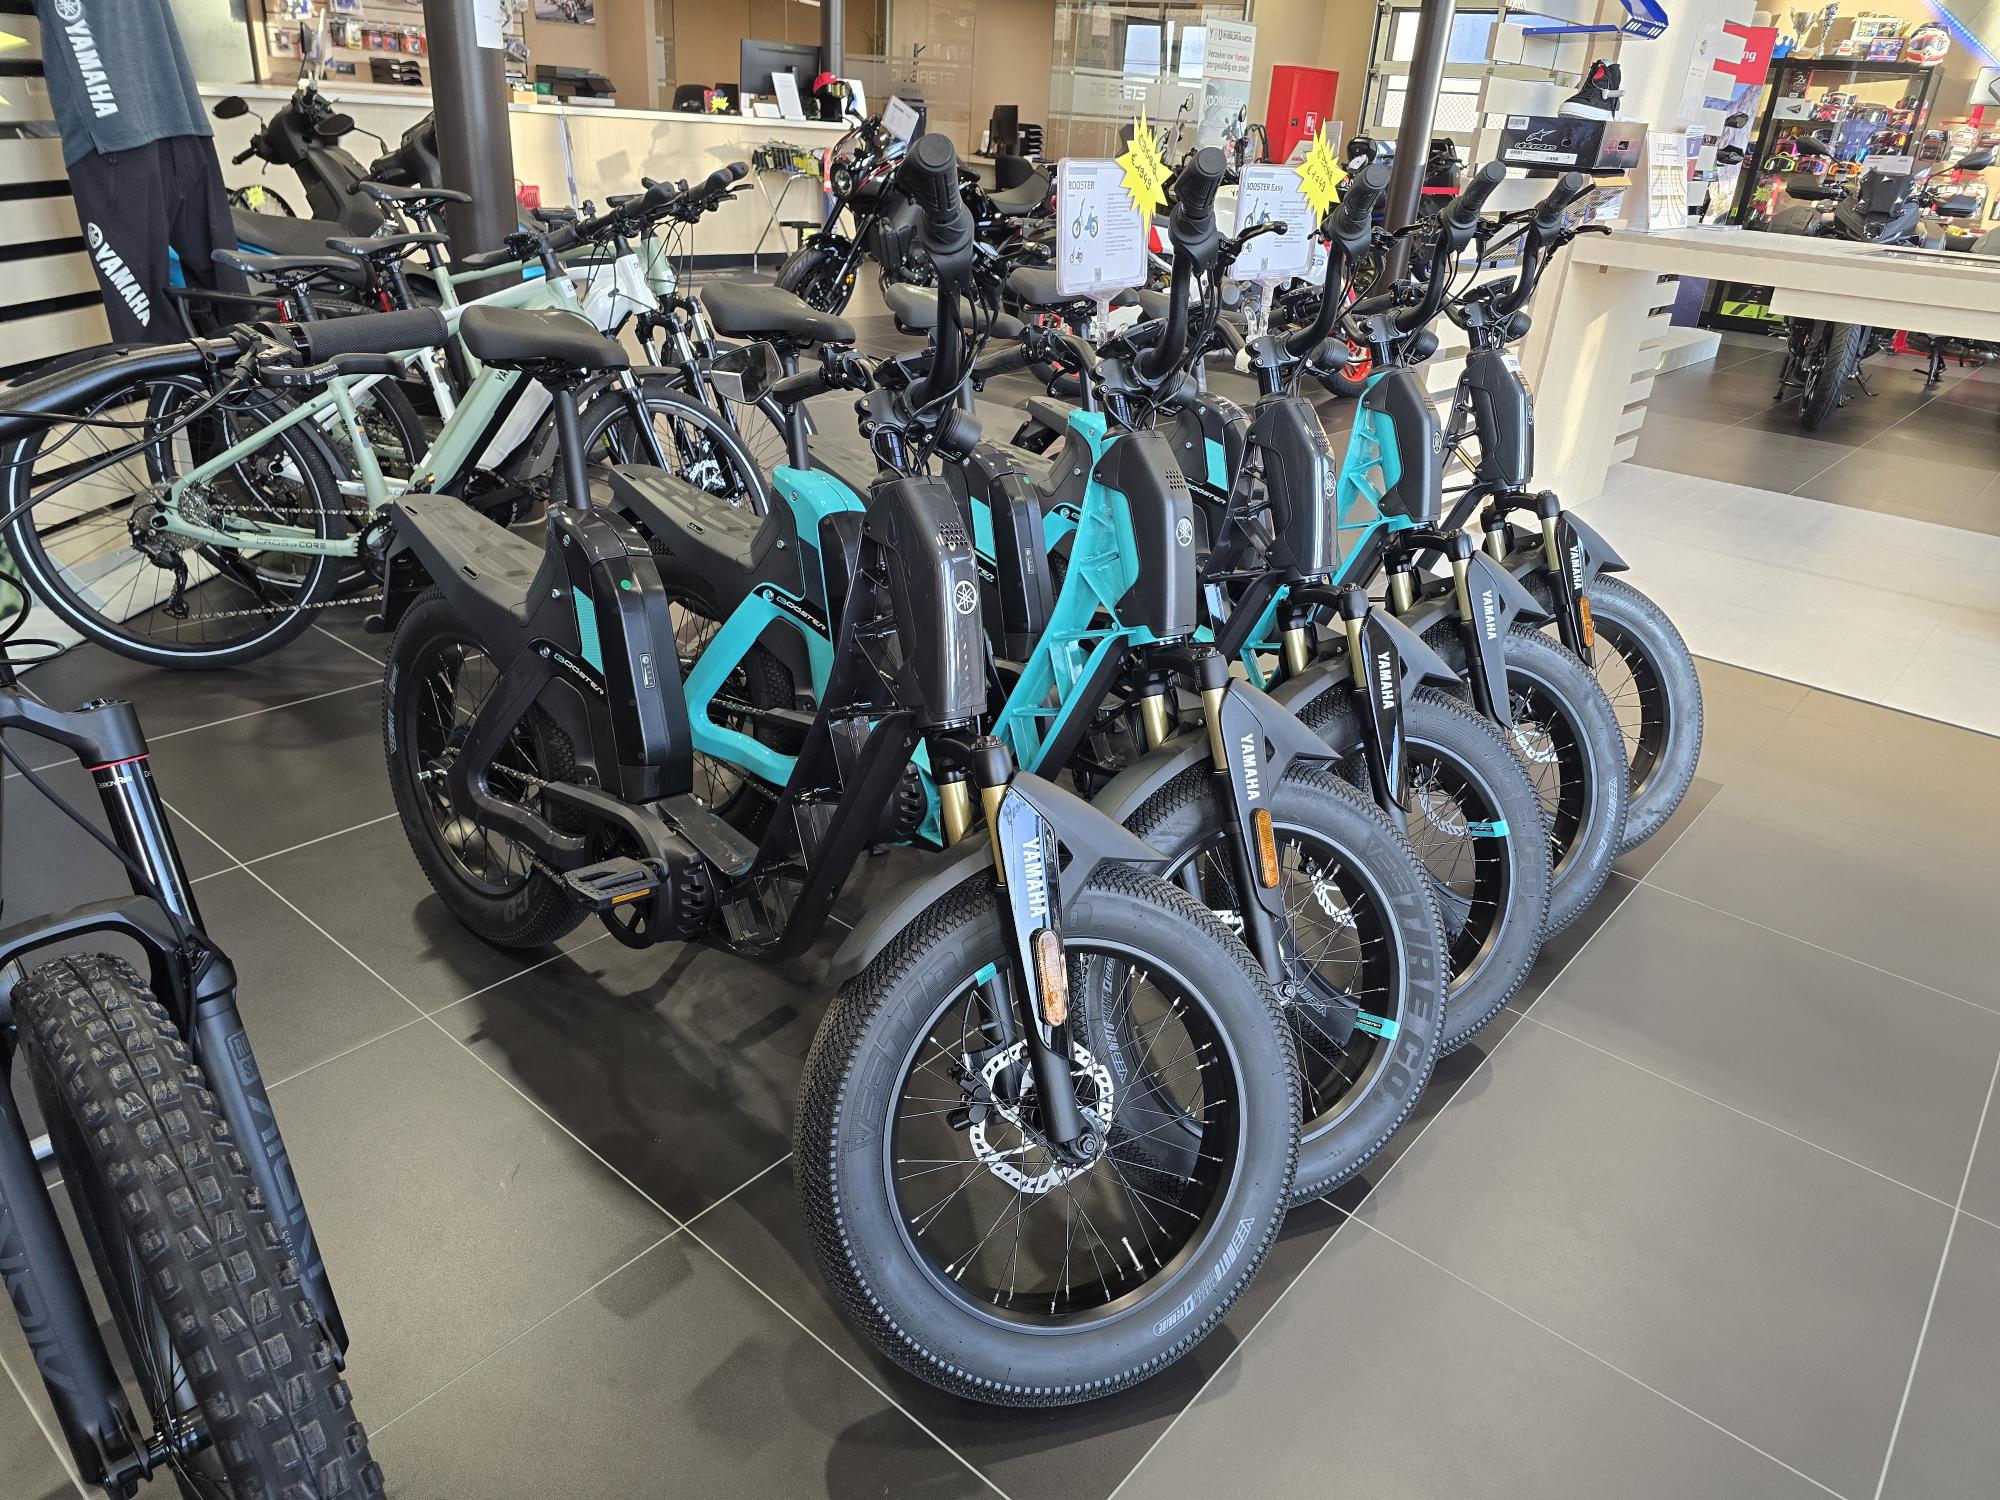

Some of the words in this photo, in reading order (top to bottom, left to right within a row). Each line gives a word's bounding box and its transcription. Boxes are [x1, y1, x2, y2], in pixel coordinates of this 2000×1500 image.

[65, 18, 119, 118] YAMAHA
[1068, 180, 1095, 190] BOOSTER
[1271, 184, 1284, 194] Easy
[95, 241, 151, 327] YAMAHA
[1569, 545, 1583, 590] YAMAHA
[775, 595, 826, 630] BOOSTER
[1482, 589, 1497, 640] YAMAHA
[553, 652, 604, 695] BOOSTER
[1377, 651, 1395, 710] YAMAHA
[1240, 732, 1261, 801] YAMAHA
[1022, 836, 1047, 919] YAMAHA
